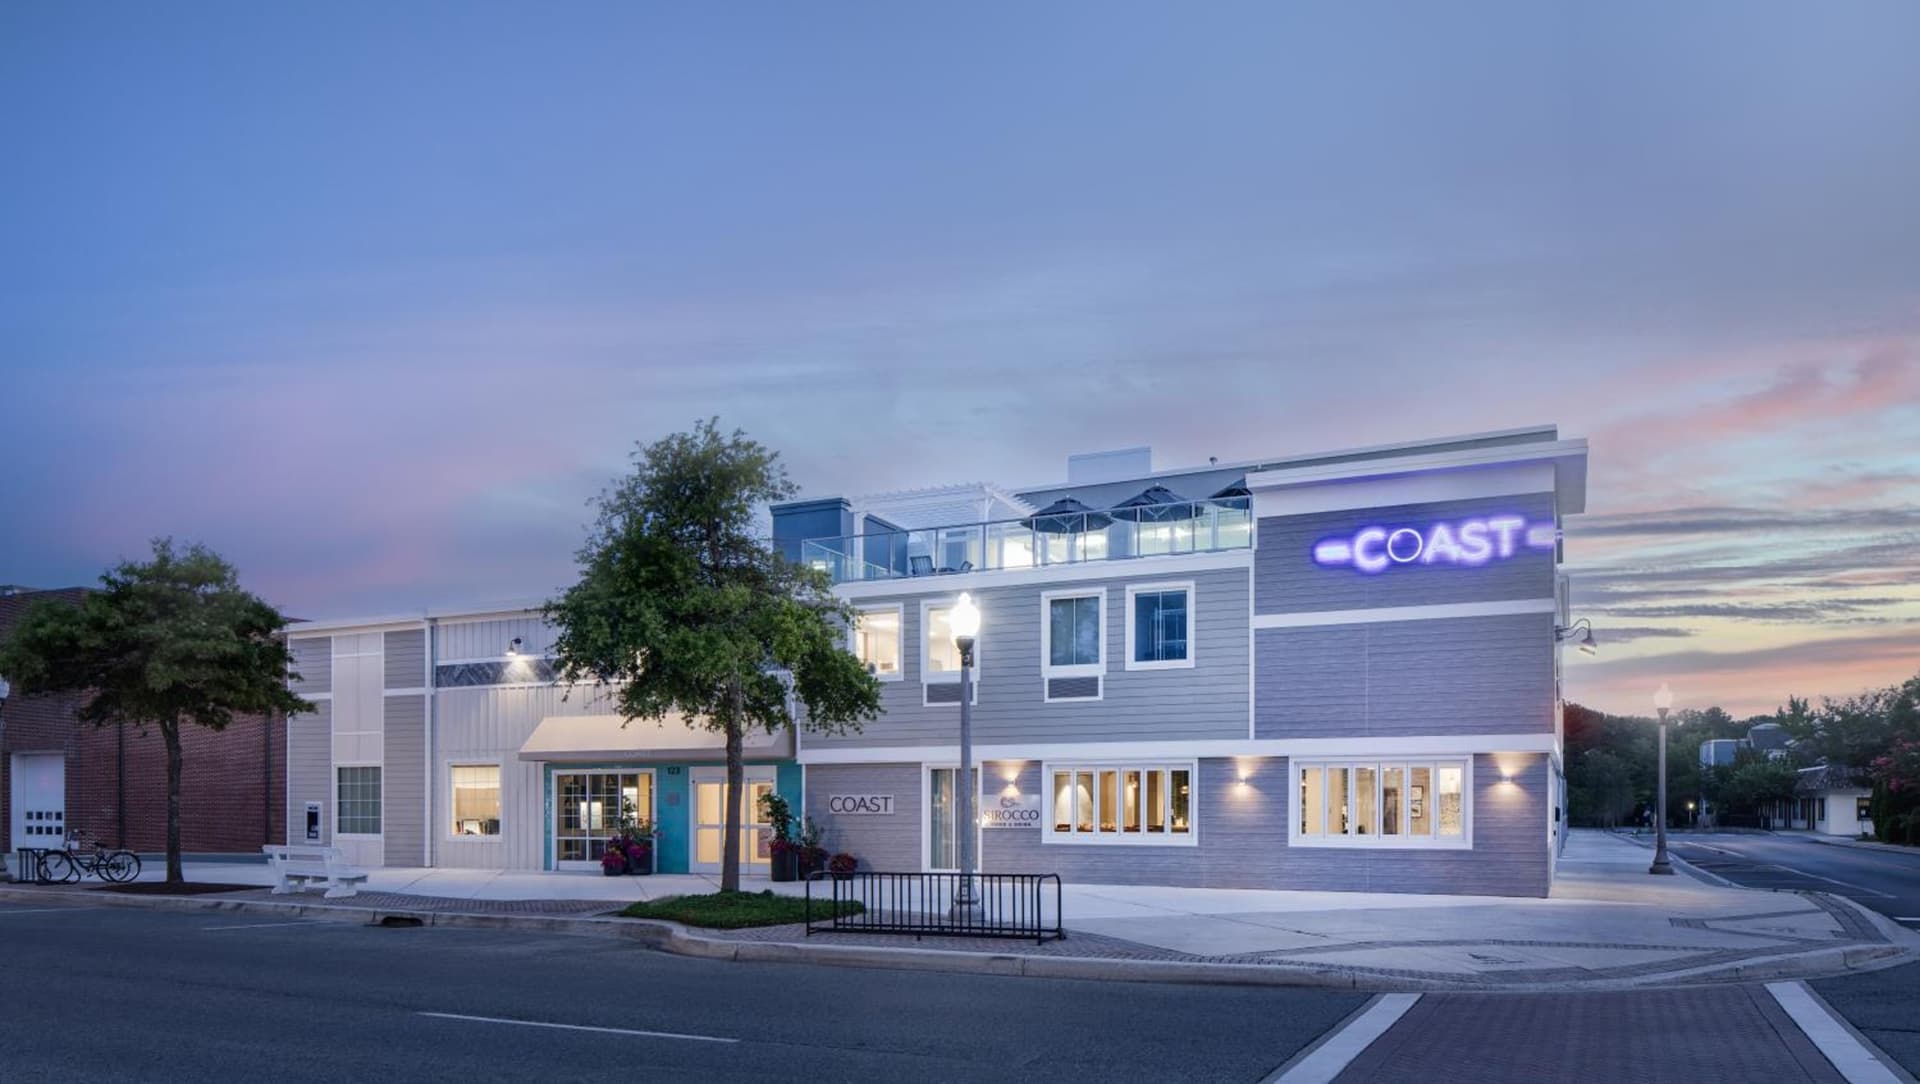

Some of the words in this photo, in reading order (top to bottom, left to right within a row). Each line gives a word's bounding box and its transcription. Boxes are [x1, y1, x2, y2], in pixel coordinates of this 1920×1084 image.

[1353, 516, 1524, 572] COAST
[830, 796, 893, 813] COAST
[983, 809, 1040, 821] SIROCCO
